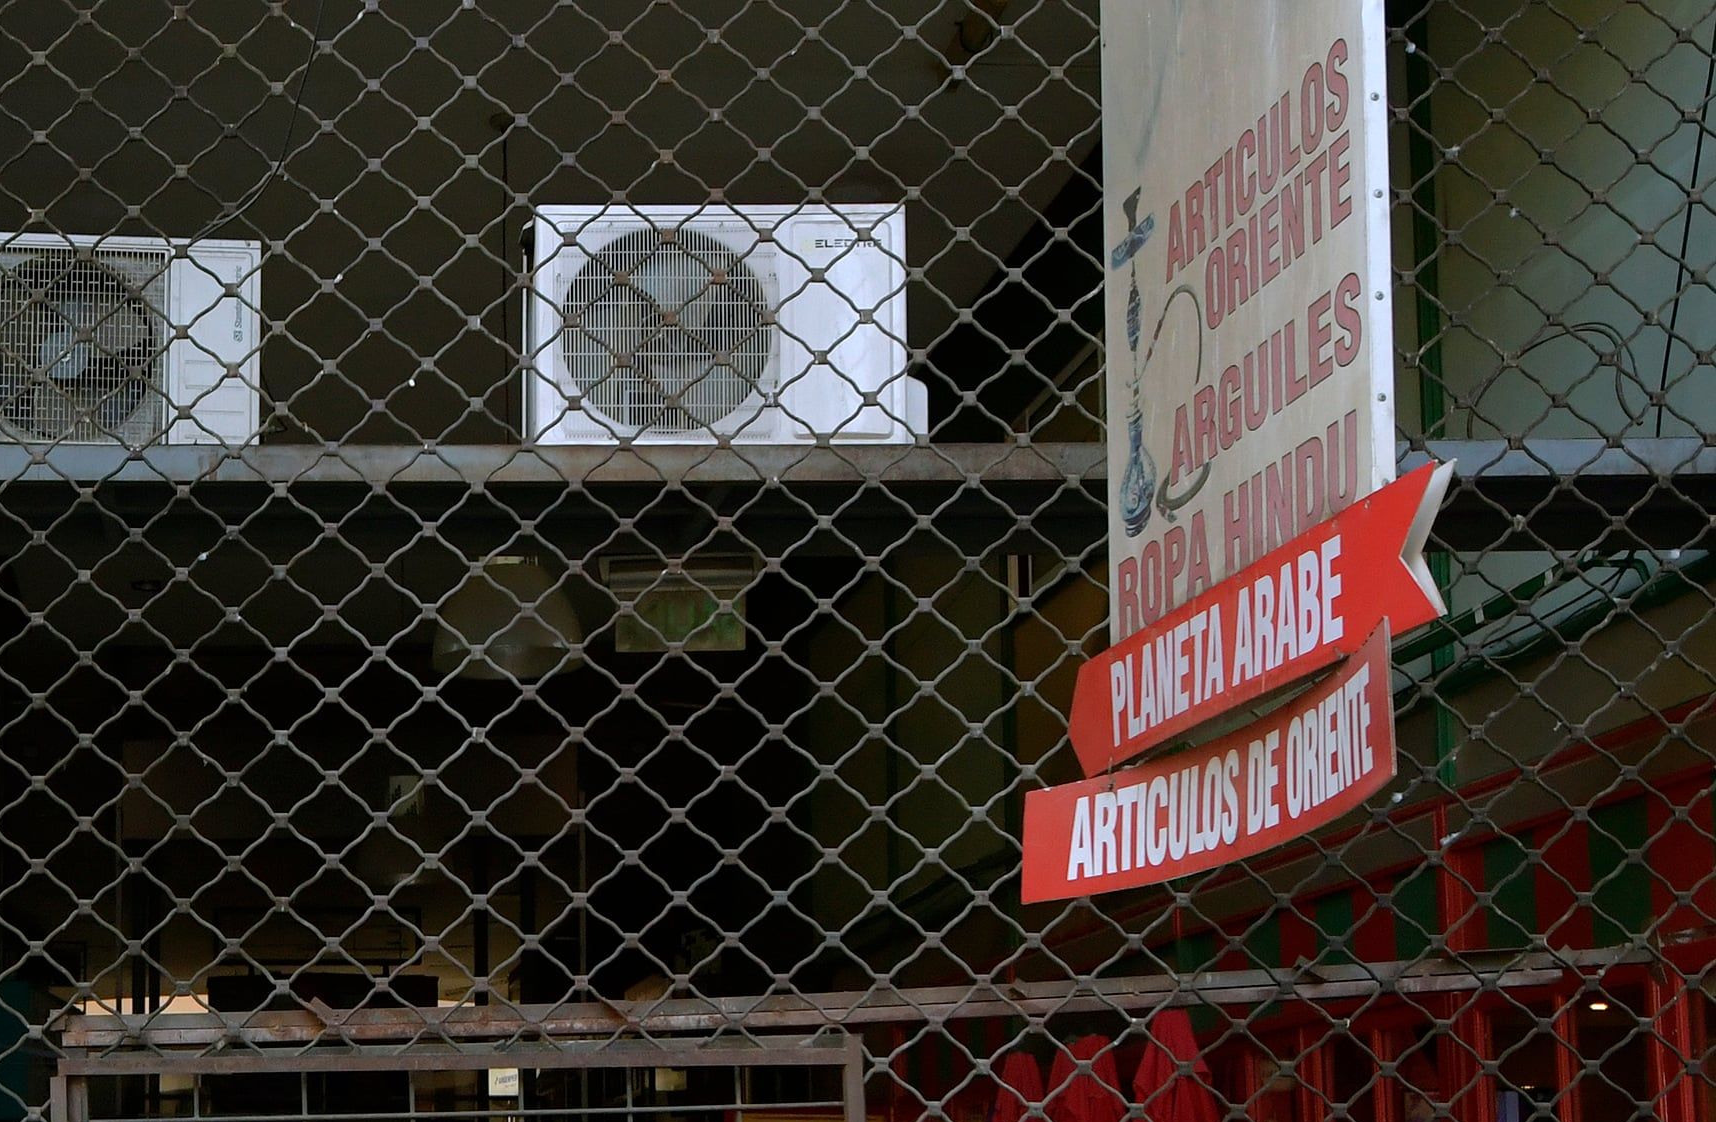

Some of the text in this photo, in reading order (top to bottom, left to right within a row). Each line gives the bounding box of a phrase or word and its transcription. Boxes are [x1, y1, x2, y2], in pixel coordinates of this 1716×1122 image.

[1165, 38, 1349, 285] ARTICULOS
[1205, 131, 1353, 330] ORIENTE
[1170, 271, 1362, 488] ARGUILES
[1118, 410, 1358, 640] ROPA HINDU
[1110, 534, 1345, 748] PLANETA ARABE
[1066, 661, 1375, 881] ARTICULOS DE ORIENTE
